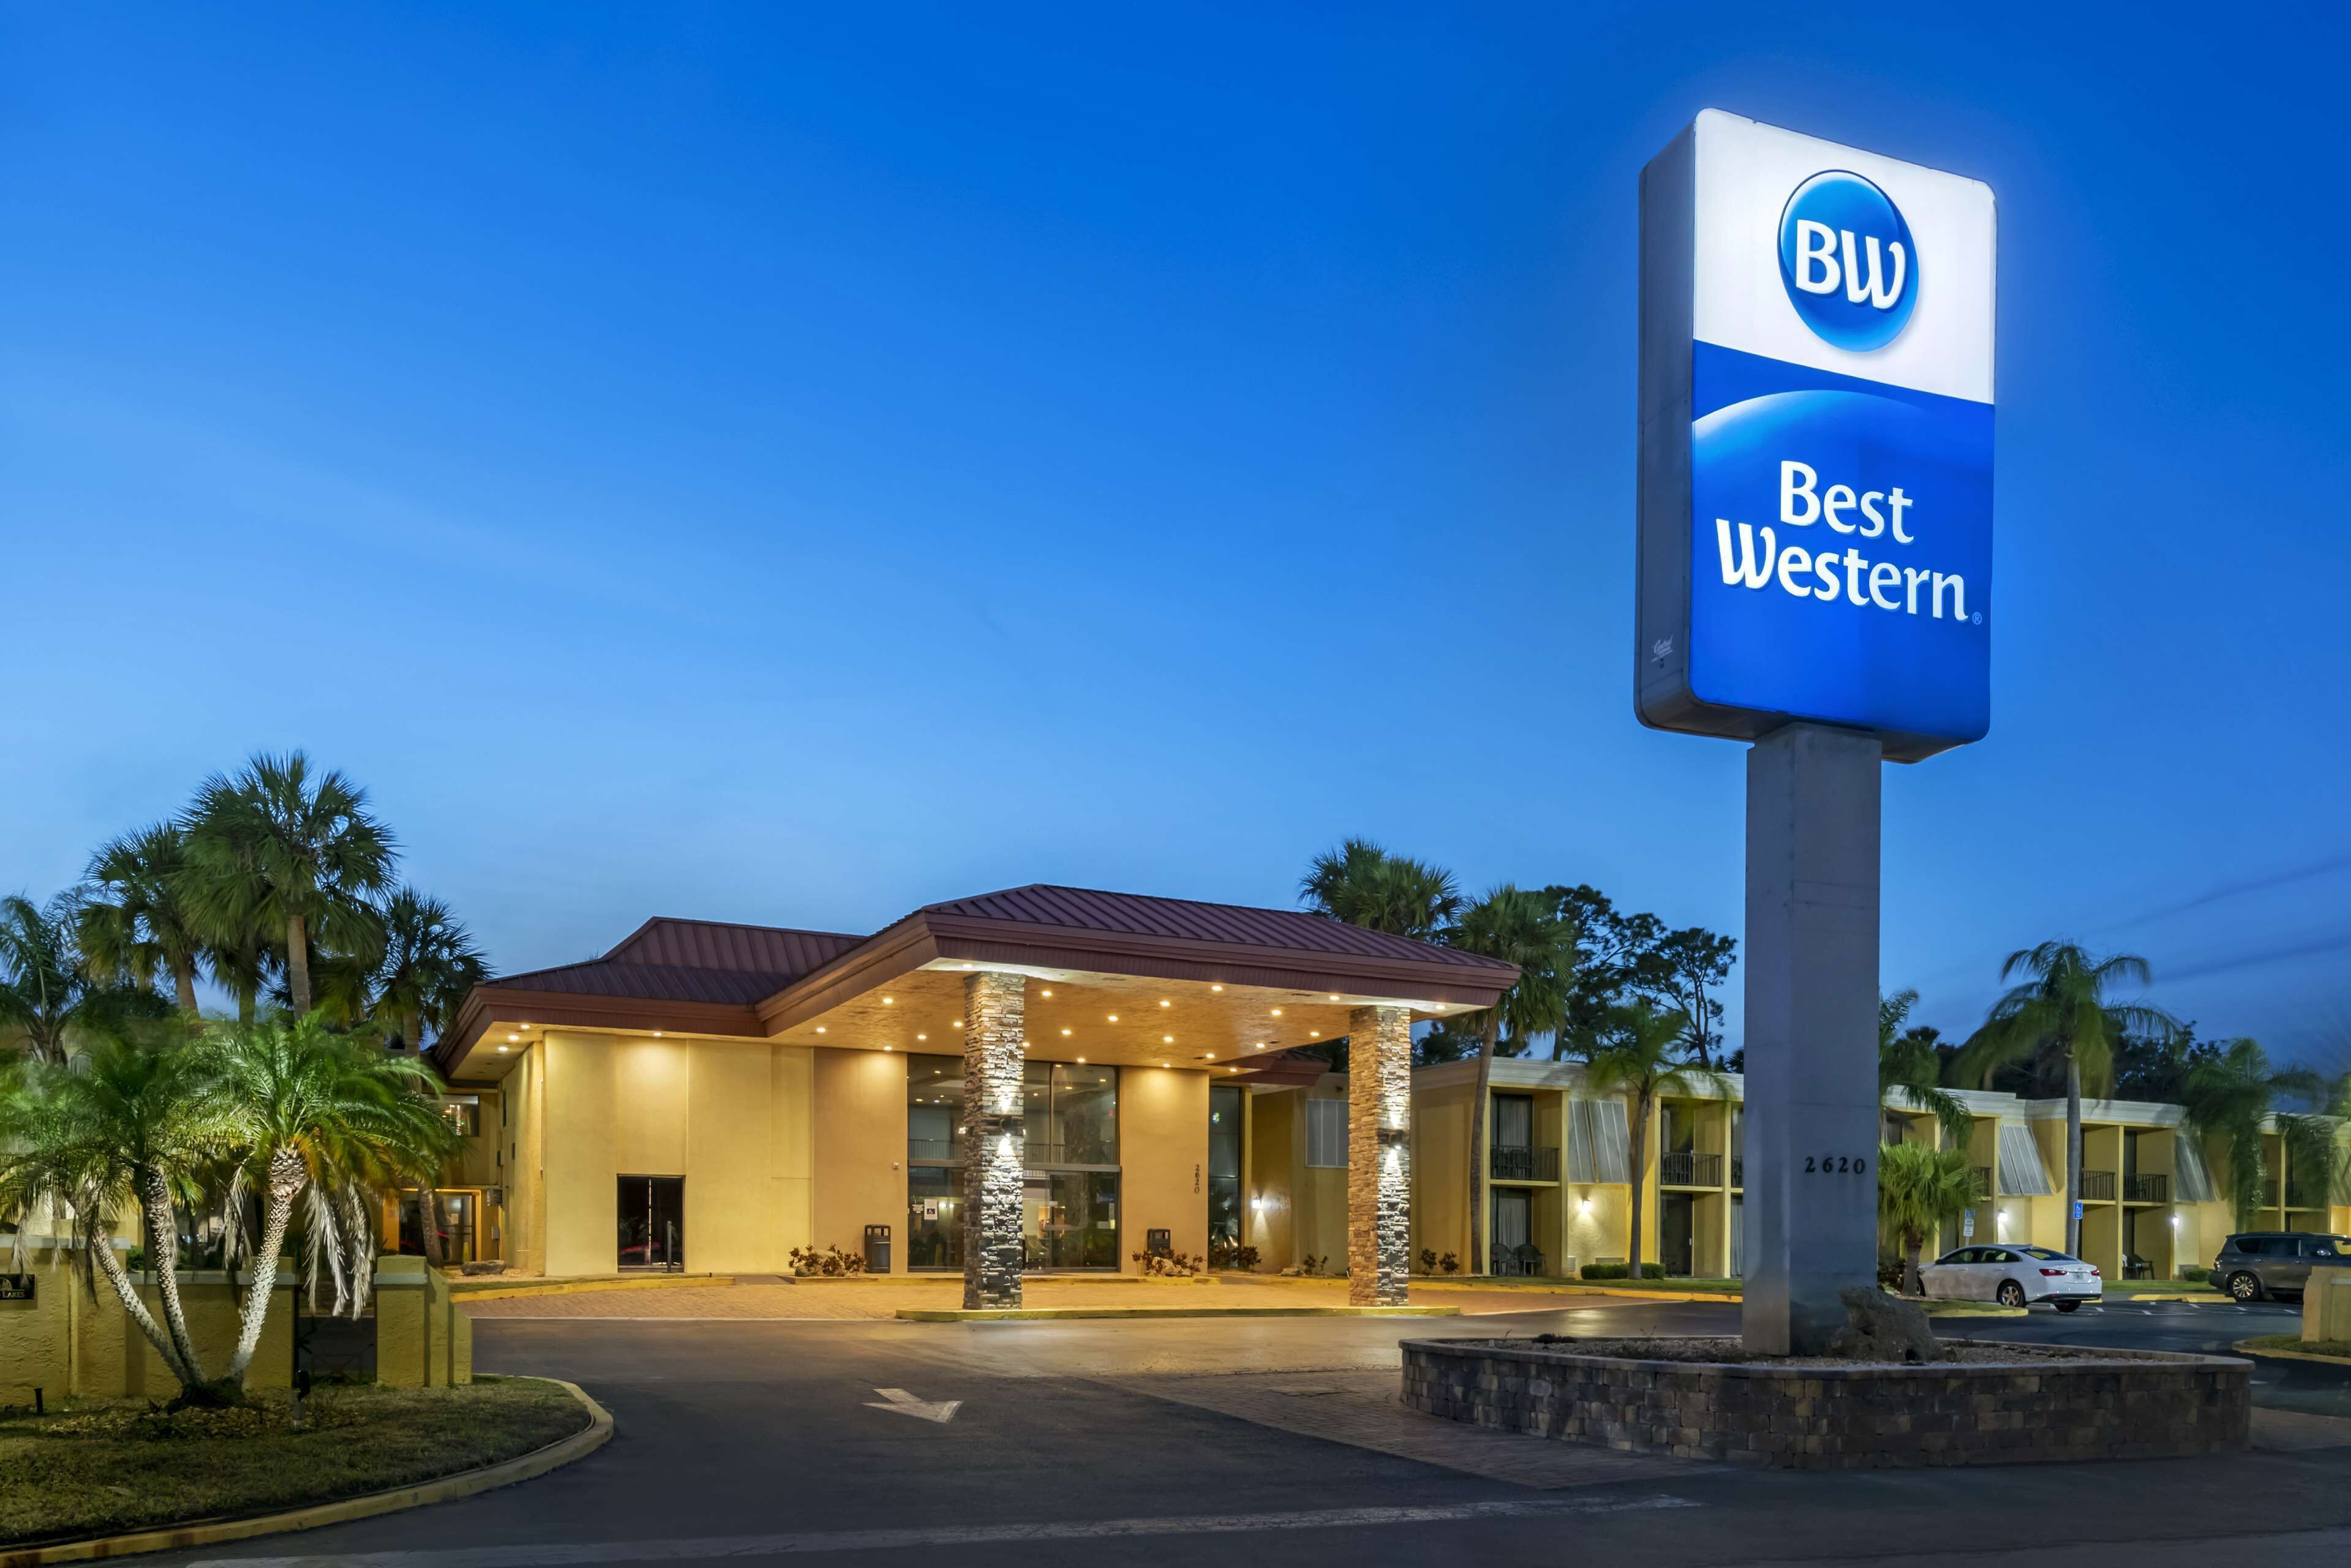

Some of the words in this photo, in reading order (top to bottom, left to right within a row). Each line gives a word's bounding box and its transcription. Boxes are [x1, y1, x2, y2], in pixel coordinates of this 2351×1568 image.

[1796, 219, 1906, 309] BW
[1780, 460, 1915, 544] Best
[1805, 1156, 1866, 1174] 2620
